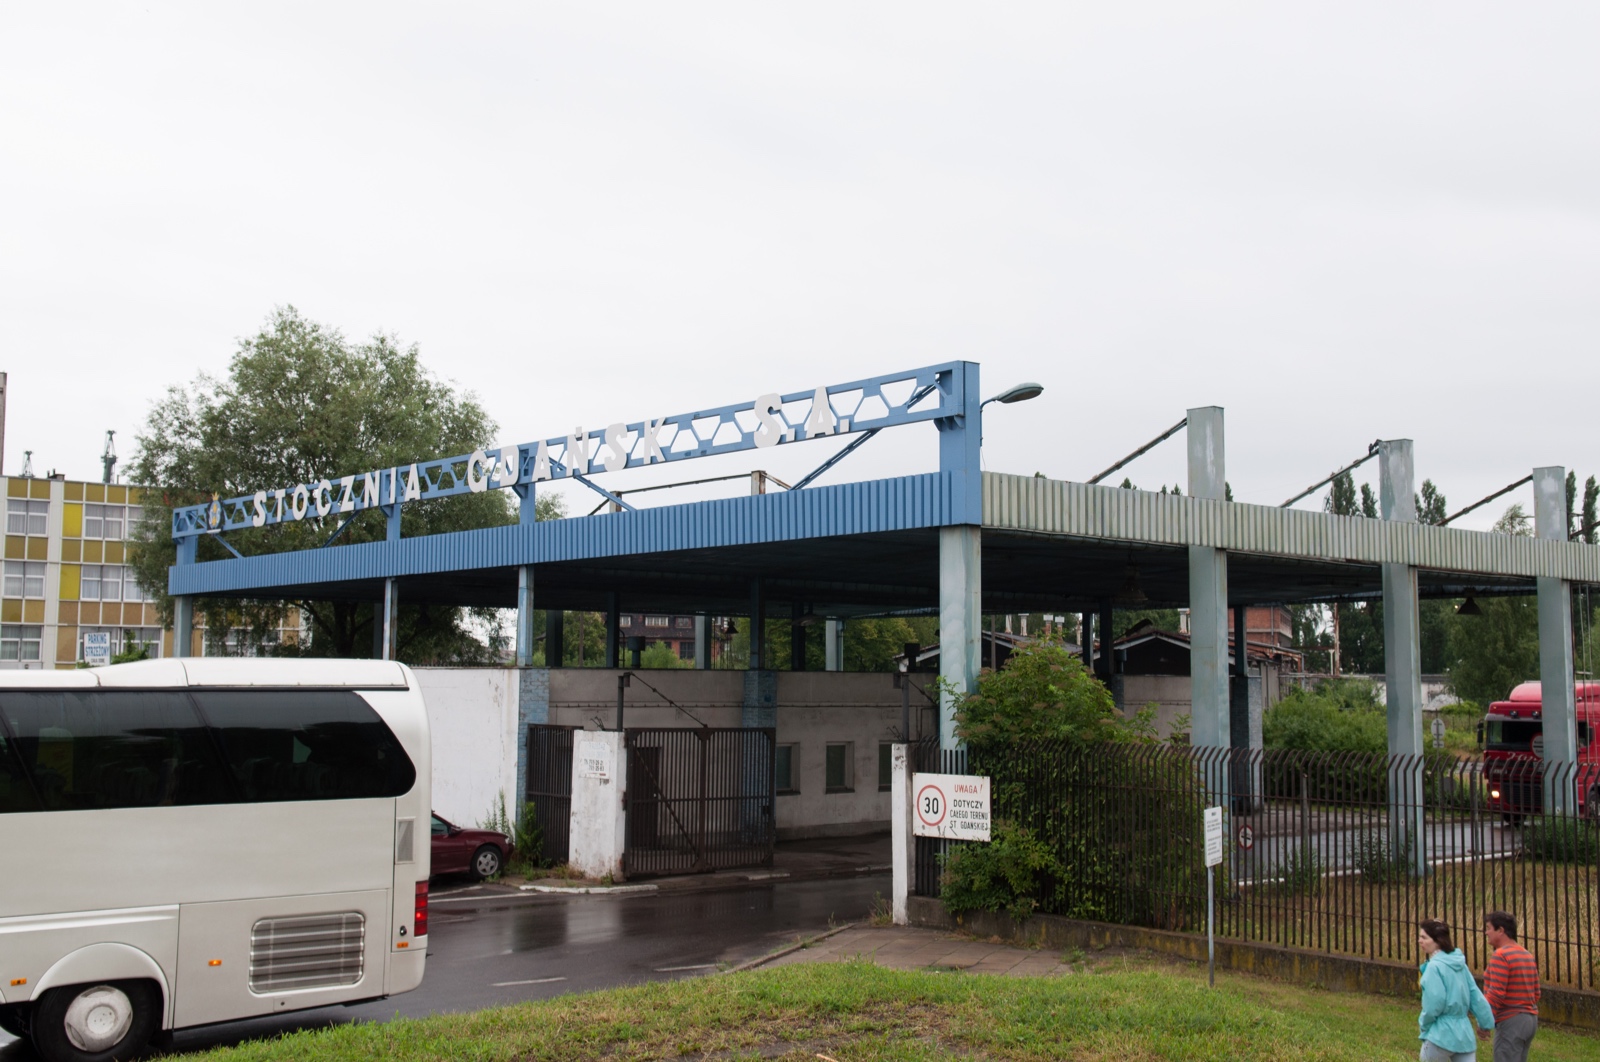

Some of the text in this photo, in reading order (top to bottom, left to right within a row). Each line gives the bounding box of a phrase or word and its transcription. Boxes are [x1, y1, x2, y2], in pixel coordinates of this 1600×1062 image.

[253, 385, 850, 527] STOCZNIA GDAŃSK S.A.
[88, 633, 107, 644] PARKING
[924, 797, 939, 815] 30
[953, 799, 983, 809] DOTYCZY
[949, 809, 988, 821] CAŁEGO TERENU
